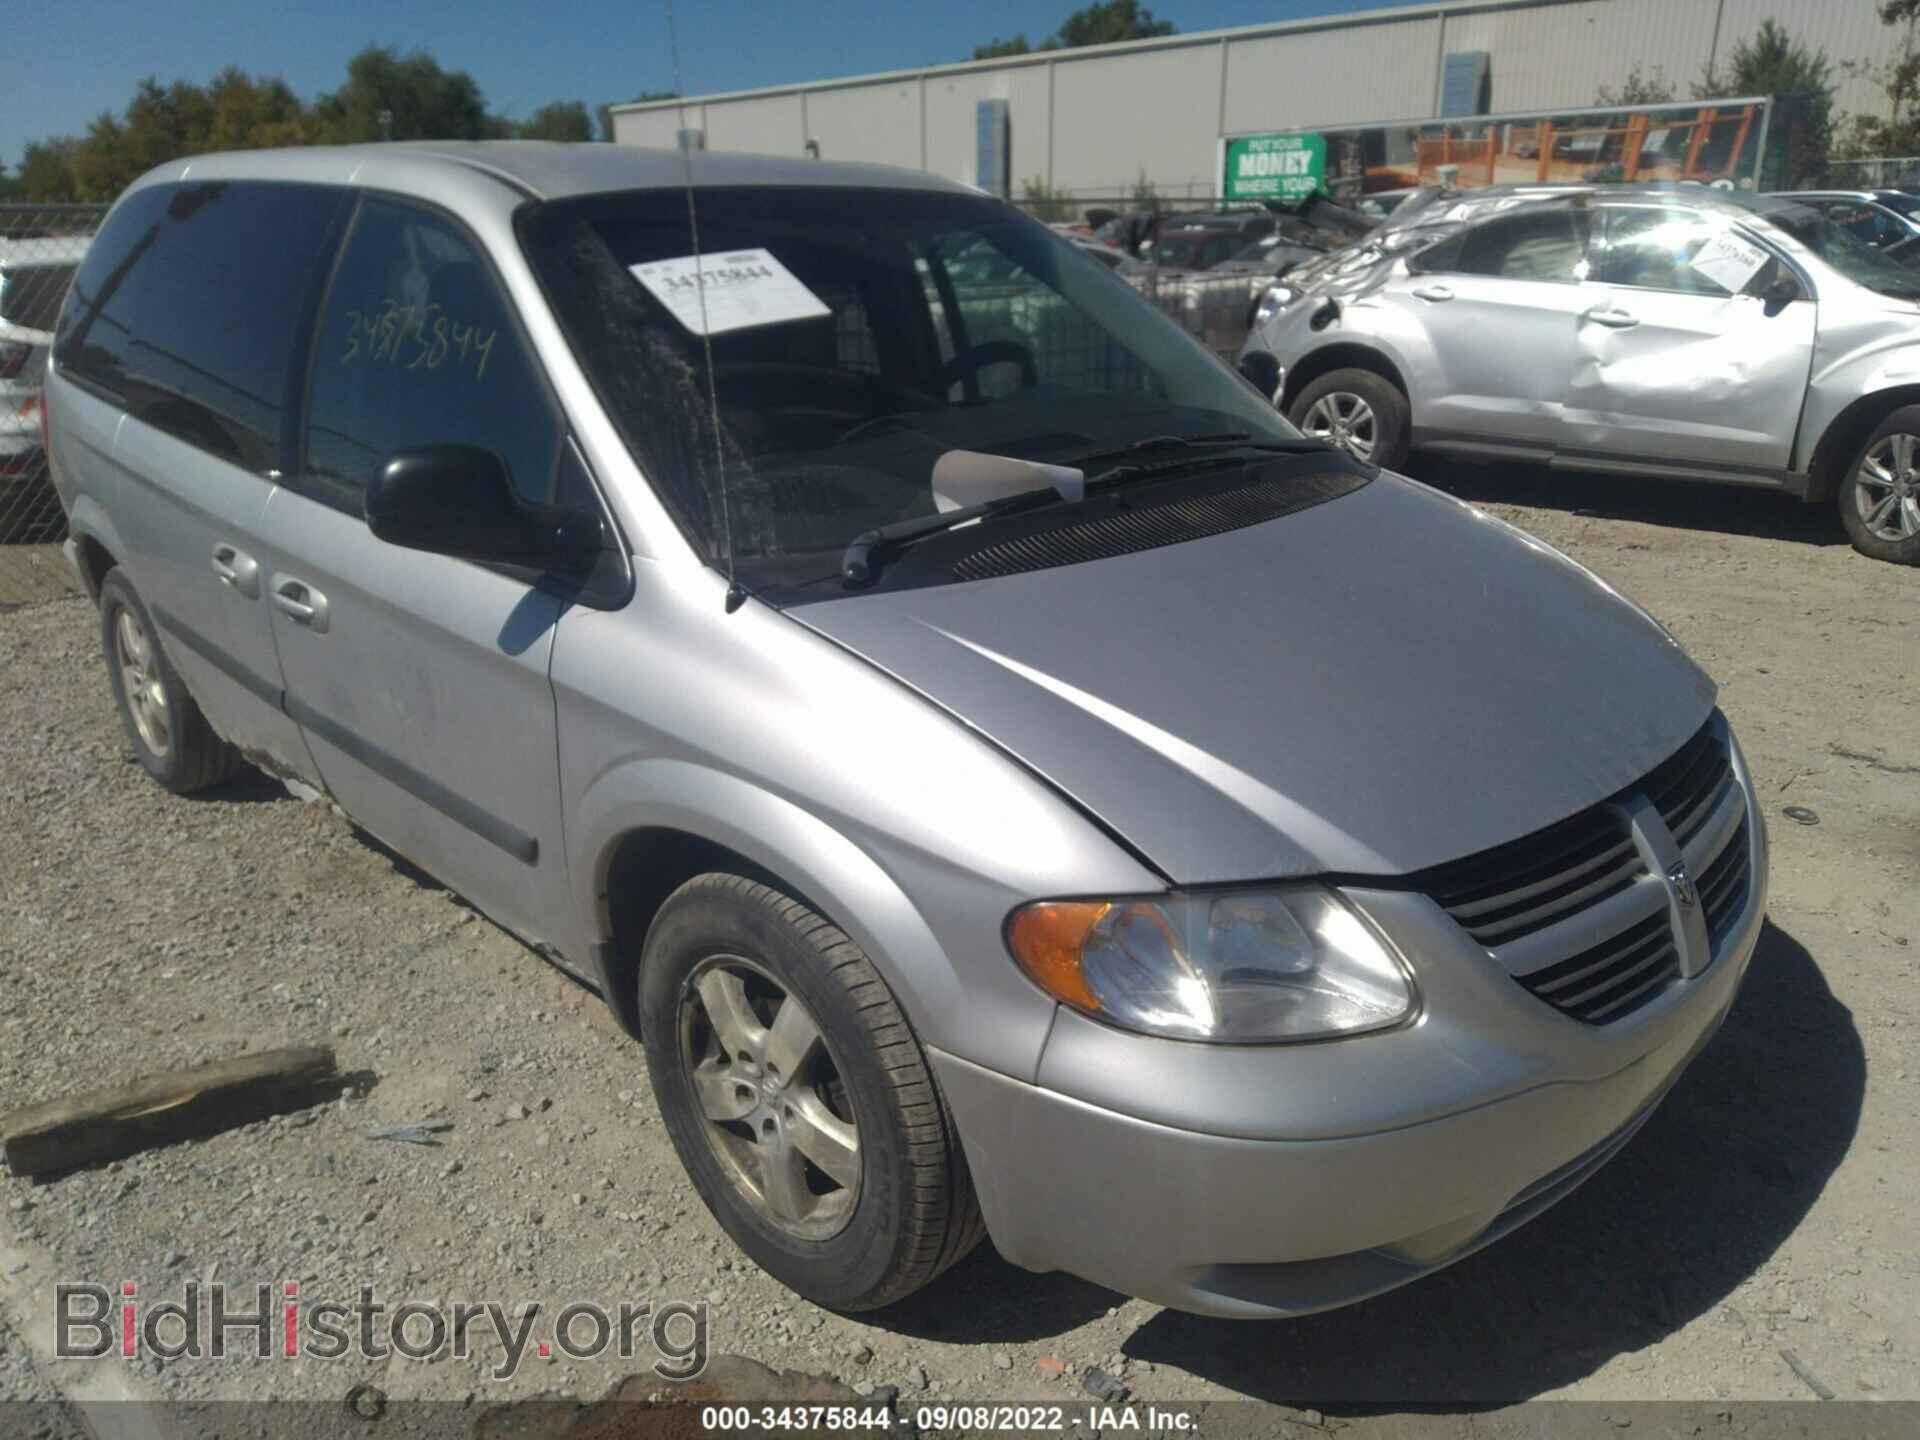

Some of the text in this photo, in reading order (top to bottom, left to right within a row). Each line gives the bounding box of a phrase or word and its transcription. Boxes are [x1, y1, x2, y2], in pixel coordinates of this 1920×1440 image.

[1248, 140, 1270, 152] PUT
[1238, 150, 1313, 176] MONEY
[1234, 176, 1317, 193] WHERE YOUR
[661, 264, 773, 290] 34375844
